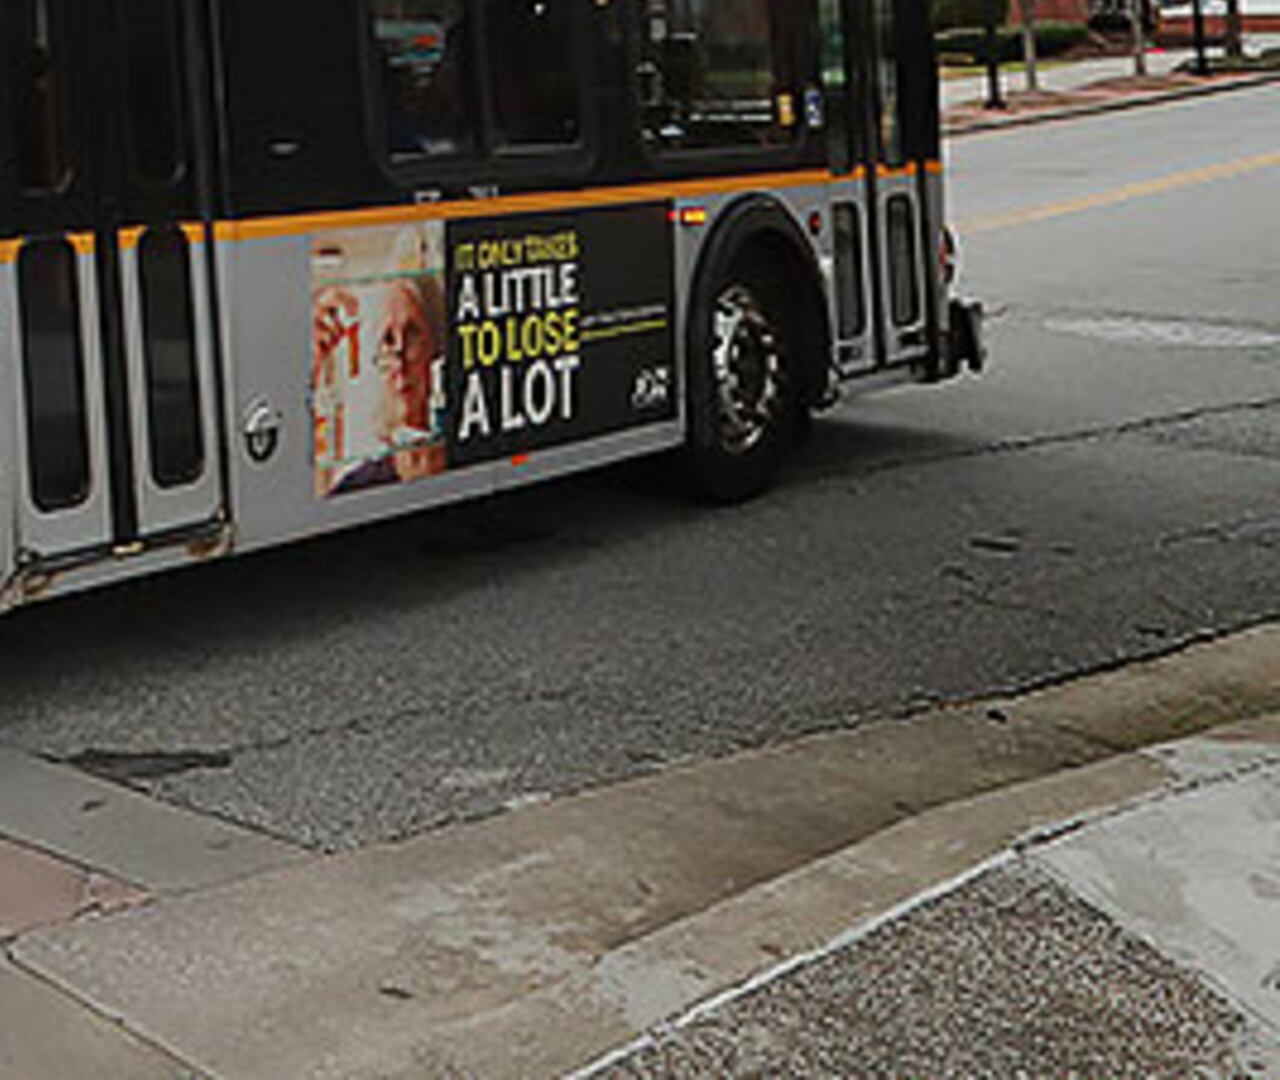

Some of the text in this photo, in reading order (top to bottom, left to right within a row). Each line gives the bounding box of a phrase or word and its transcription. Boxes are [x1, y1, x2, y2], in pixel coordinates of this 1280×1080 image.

[457, 273, 480, 321] A
[483, 261, 579, 317] LITTLE
[458, 320, 500, 370] TO
[506, 307, 579, 361] LOSE
[458, 371, 490, 440] A
[501, 354, 580, 430] LOT
